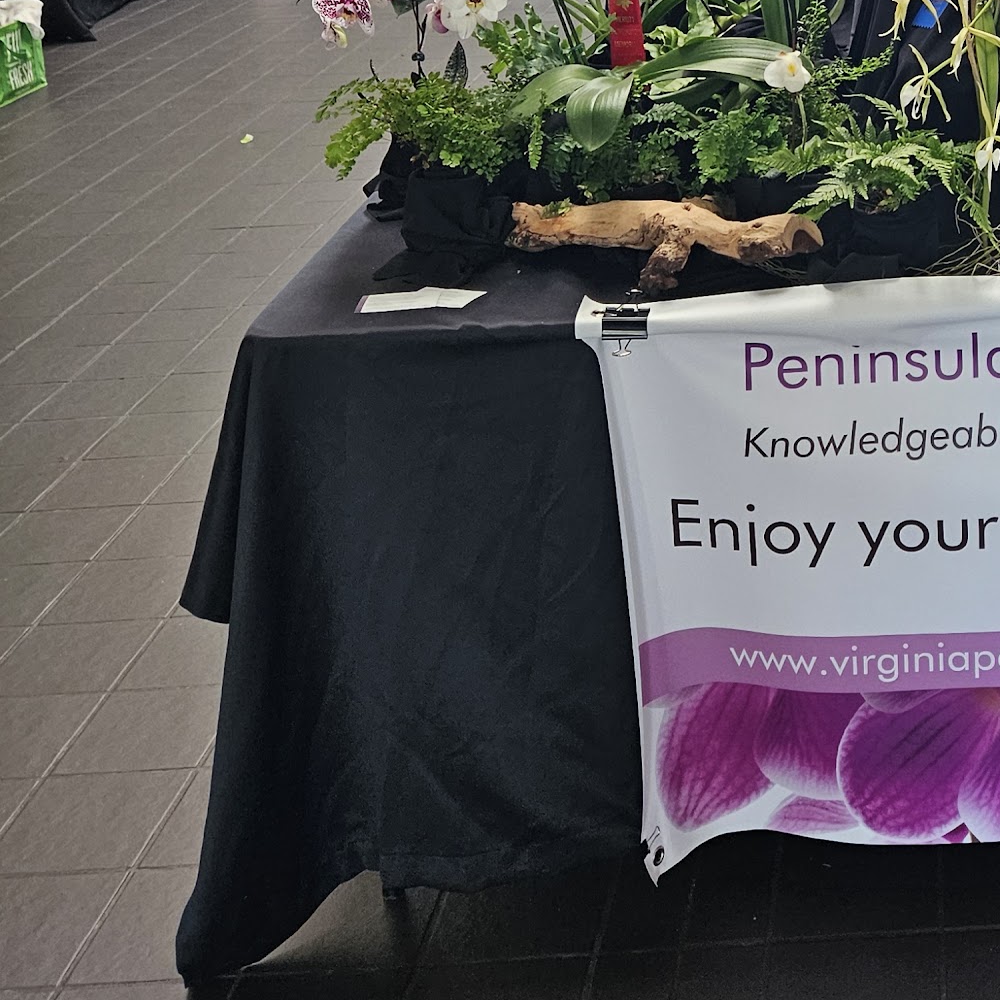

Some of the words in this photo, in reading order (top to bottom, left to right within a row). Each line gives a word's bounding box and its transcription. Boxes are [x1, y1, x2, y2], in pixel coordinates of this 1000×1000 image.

[8, 60, 34, 90] FRESH
[670, 498, 836, 568] Enjoy
[857, 516, 999, 567] your
